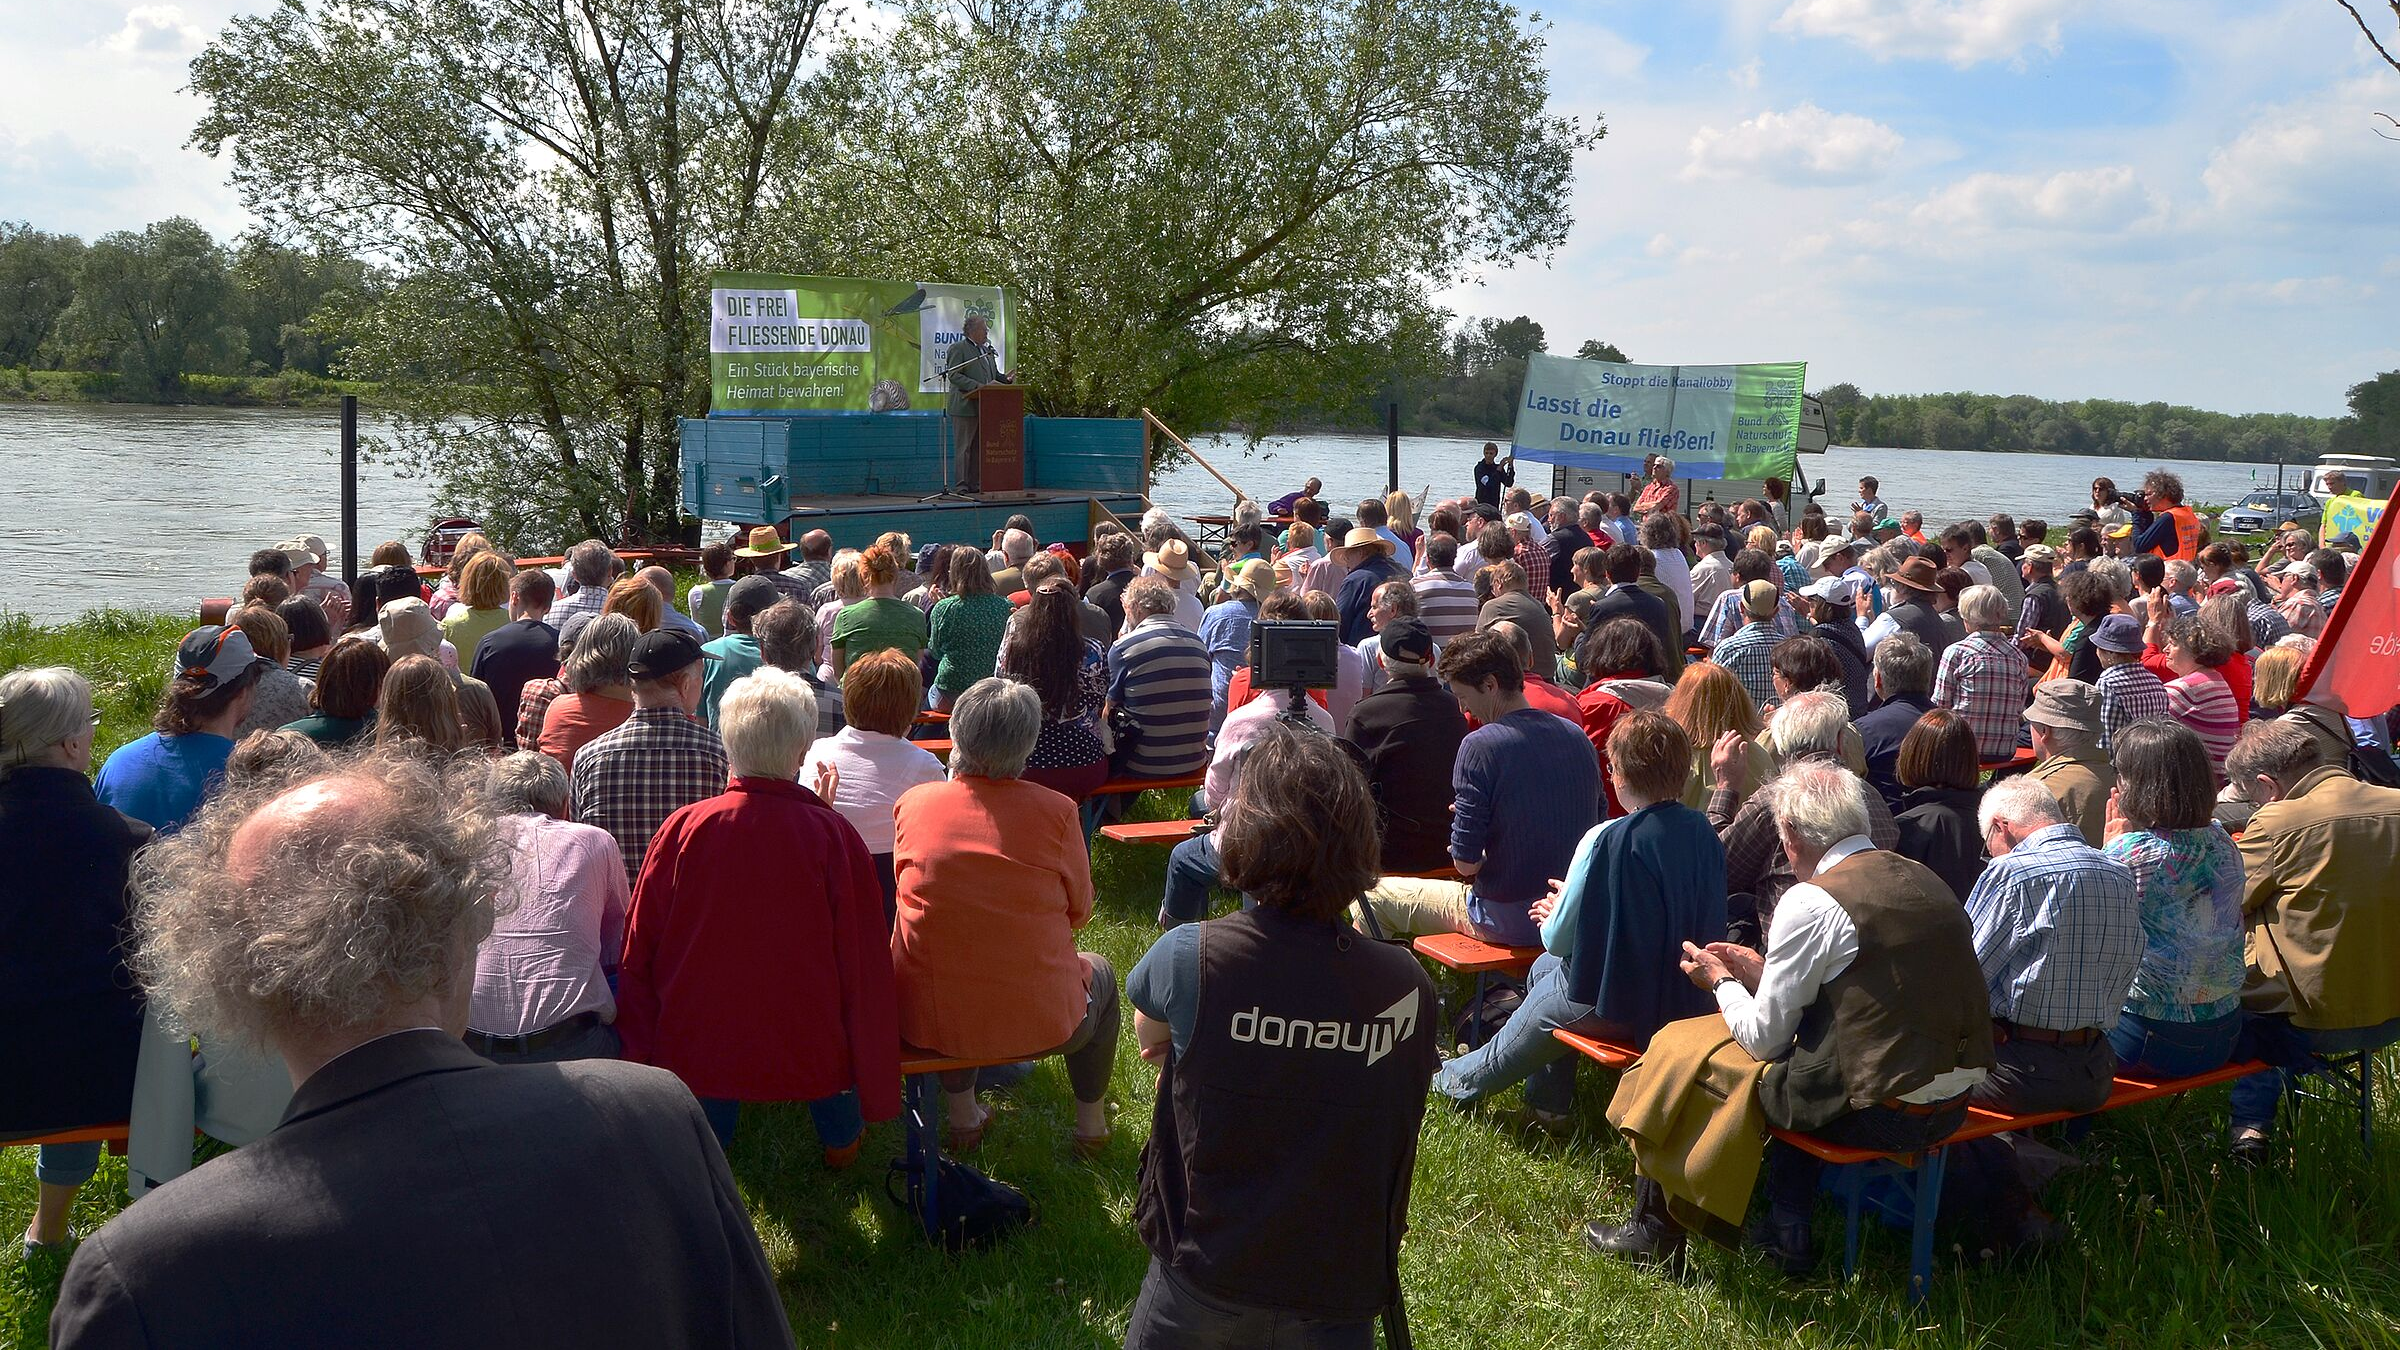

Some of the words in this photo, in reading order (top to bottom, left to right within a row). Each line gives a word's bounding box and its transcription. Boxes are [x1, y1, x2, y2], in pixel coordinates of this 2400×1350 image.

[727, 297, 752, 317] DIE
[757, 297, 788, 317] FREI
[728, 325, 816, 346] FLIESSENDE
[821, 326, 865, 346] DONAU
[728, 363, 749, 378] Ein
[753, 362, 790, 378] Stück
[793, 362, 859, 380] bayerische
[1601, 372, 1645, 389] Stoppt
[1648, 375, 1668, 387] die
[1671, 376, 1733, 390] Kanallobby
[726, 384, 775, 400] Heimat
[778, 383, 844, 398] bewahren!
[1526, 389, 1581, 416] Lasst
[1586, 398, 1622, 419] die
[1738, 416, 1762, 426] Bund
[1559, 422, 1631, 446] Donau
[1638, 428, 1716, 451] fließen!
[1736, 429, 1793, 440] Naturschutz
[1735, 443, 1743, 453] in
[1745, 443, 1774, 455] Bayern
